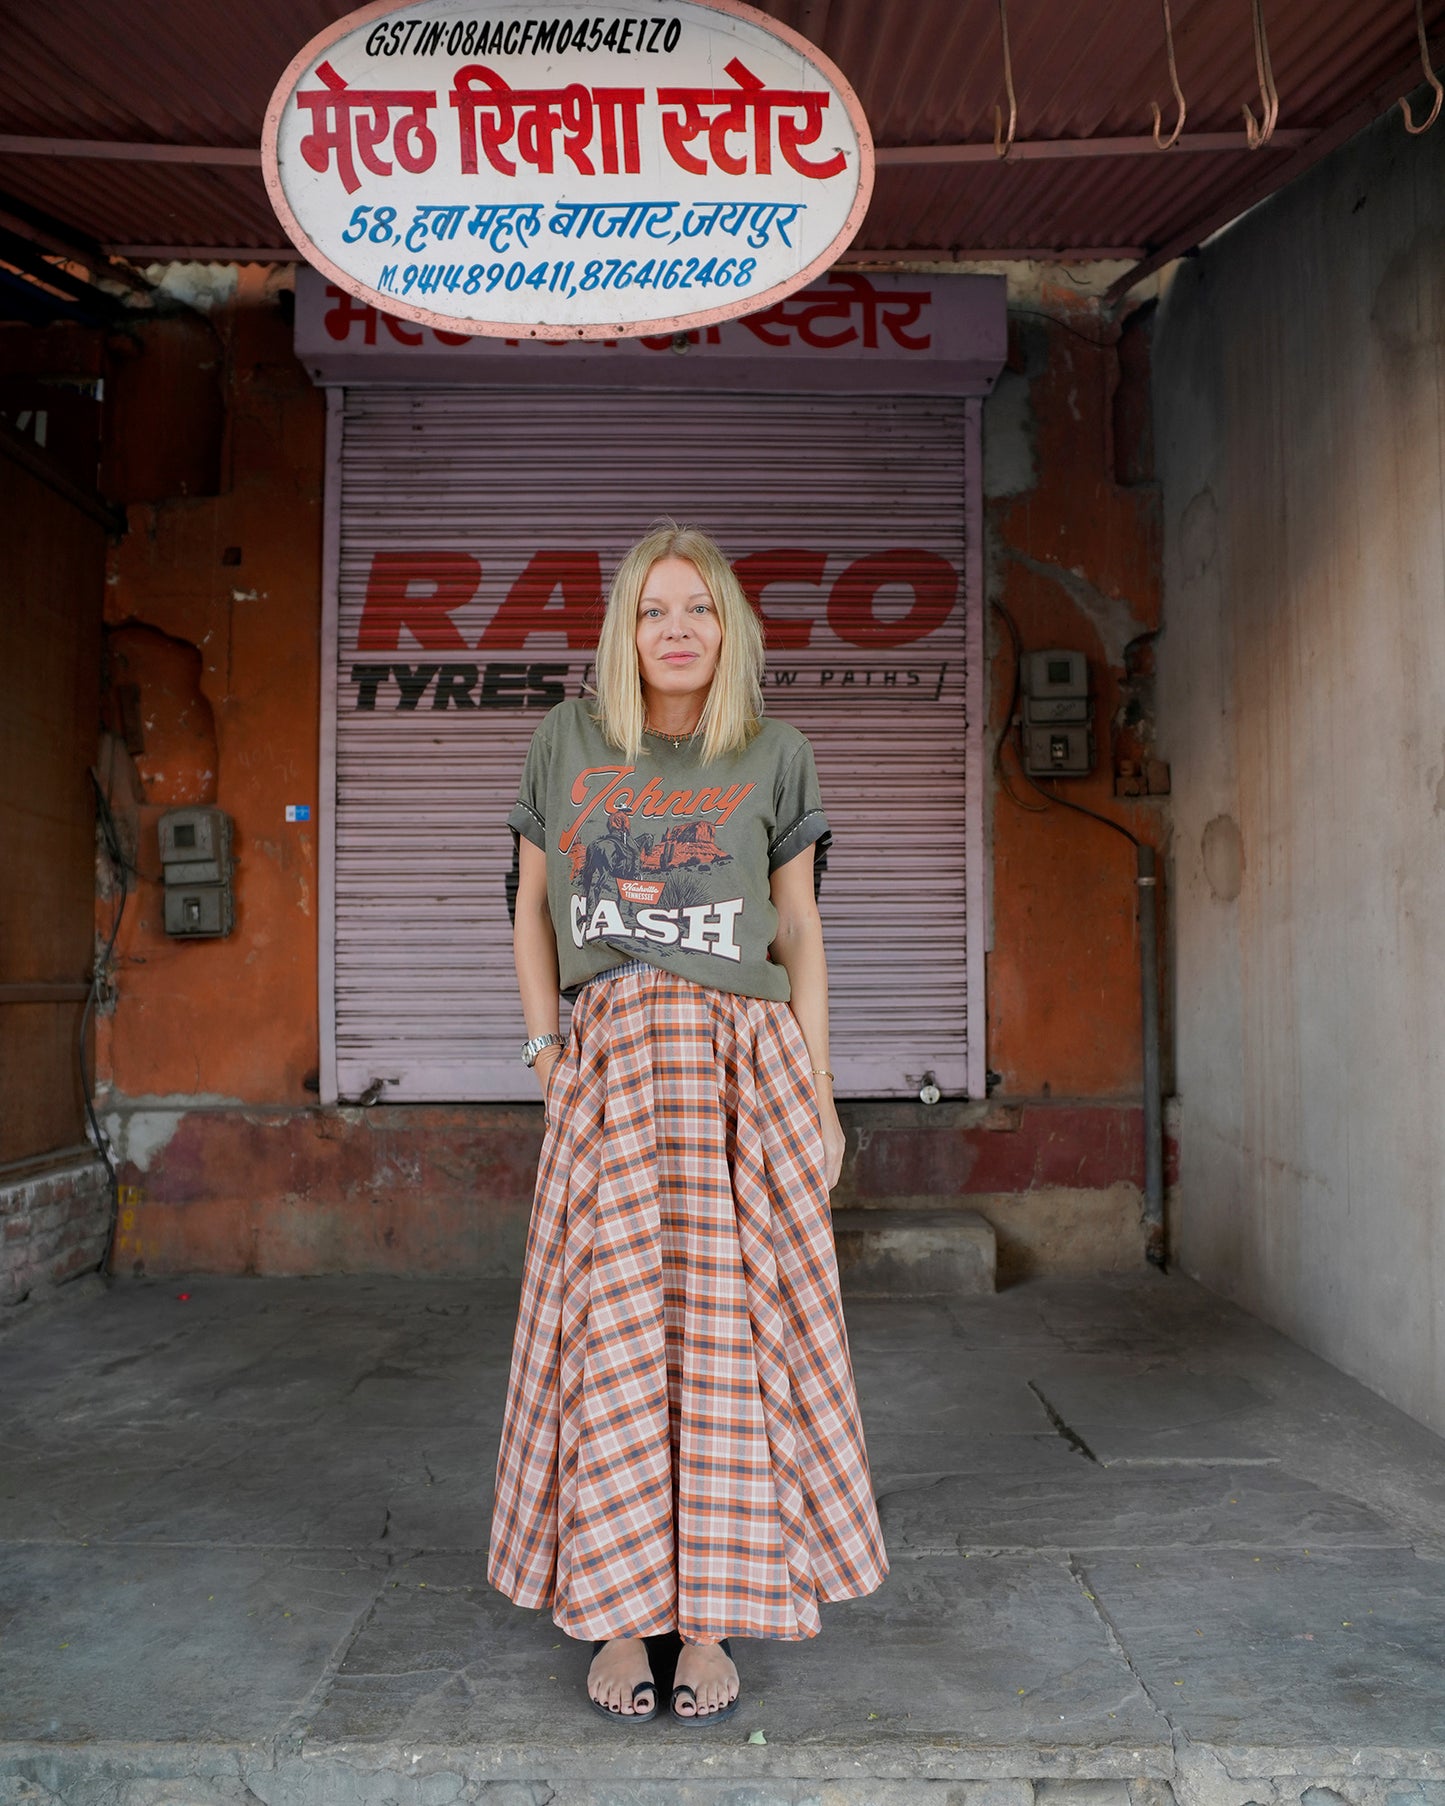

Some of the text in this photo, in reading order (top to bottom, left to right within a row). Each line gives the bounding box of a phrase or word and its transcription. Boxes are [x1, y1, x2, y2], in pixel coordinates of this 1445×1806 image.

[296, 56, 849, 195] मेरठ रिक्शा स्टोर
[467, 203, 545, 254] महल
[356, 549, 960, 650] RACO
[350, 663, 570, 711] TYRES
[820, 671, 921, 686] PATHS
[558, 765, 758, 856] Johnny
[621, 882, 660, 894] Nashville
[625, 891, 655, 901] TENNESSEE
[570, 894, 745, 964] CASH
